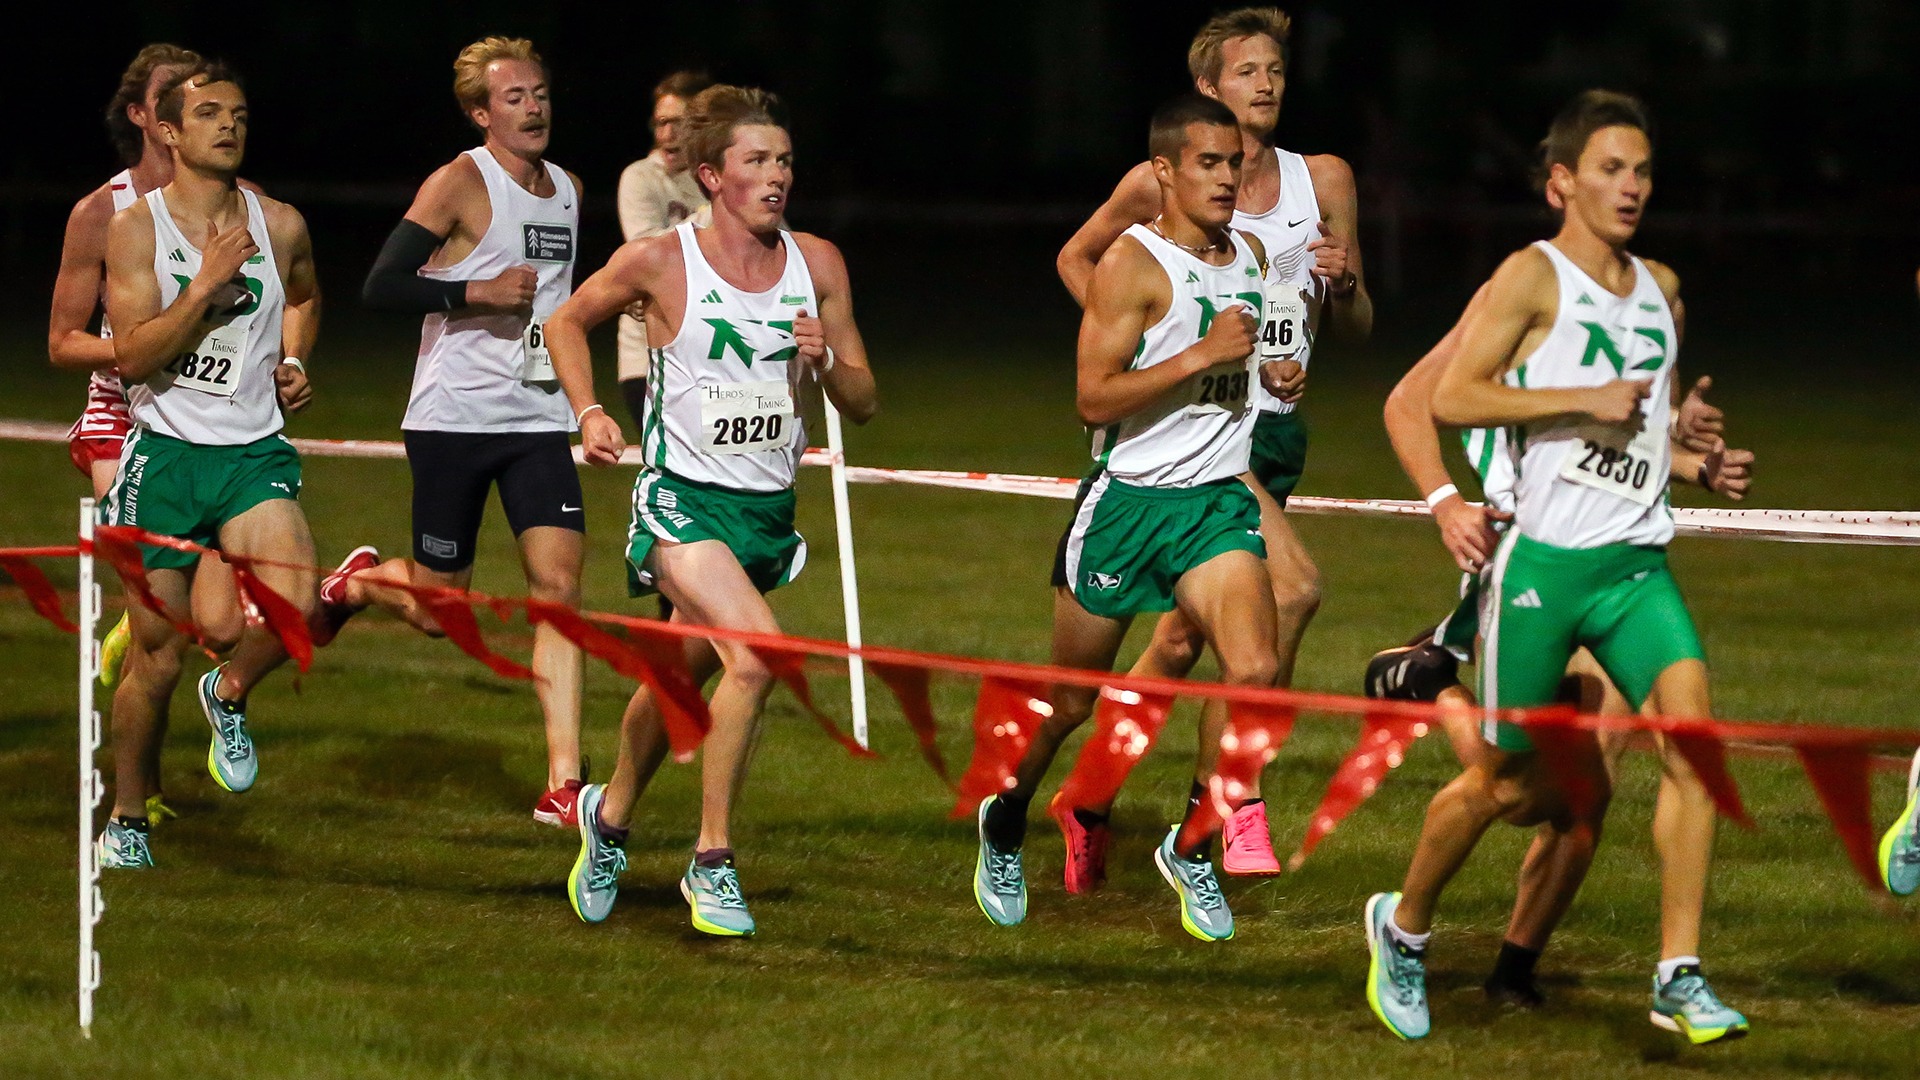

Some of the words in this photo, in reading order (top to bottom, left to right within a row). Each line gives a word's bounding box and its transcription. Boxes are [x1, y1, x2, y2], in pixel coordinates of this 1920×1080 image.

[755, 395, 786, 410] TIMING
[713, 414, 782, 445] 2820
[1577, 441, 1649, 489] 2830
